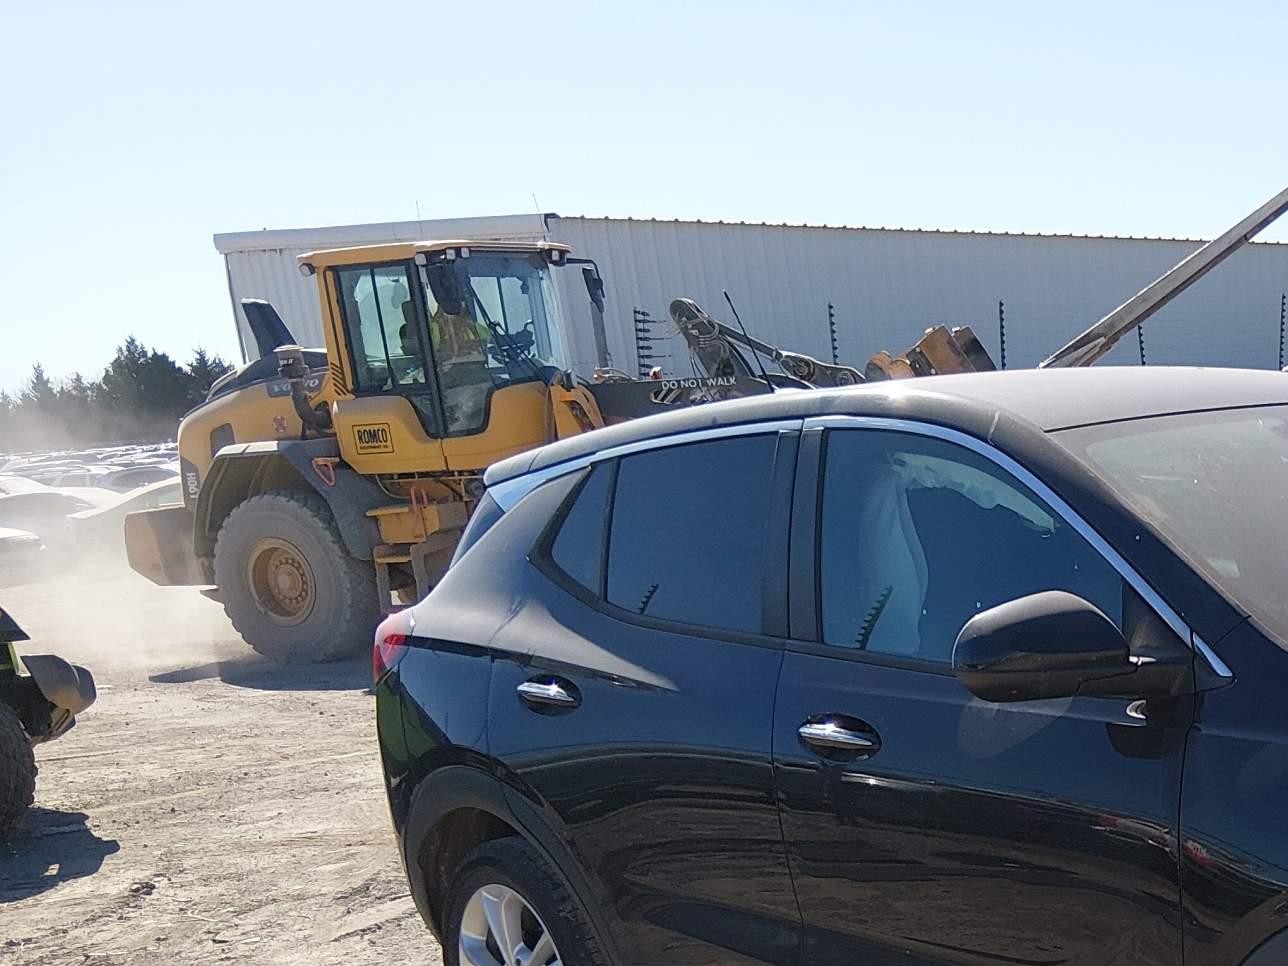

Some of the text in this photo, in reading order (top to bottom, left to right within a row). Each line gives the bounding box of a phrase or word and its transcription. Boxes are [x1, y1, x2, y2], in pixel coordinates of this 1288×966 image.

[273, 378, 320, 393] VOO
[661, 381, 678, 389] DO
[706, 376, 737, 387] WALK
[356, 428, 388, 444] ROMCO
